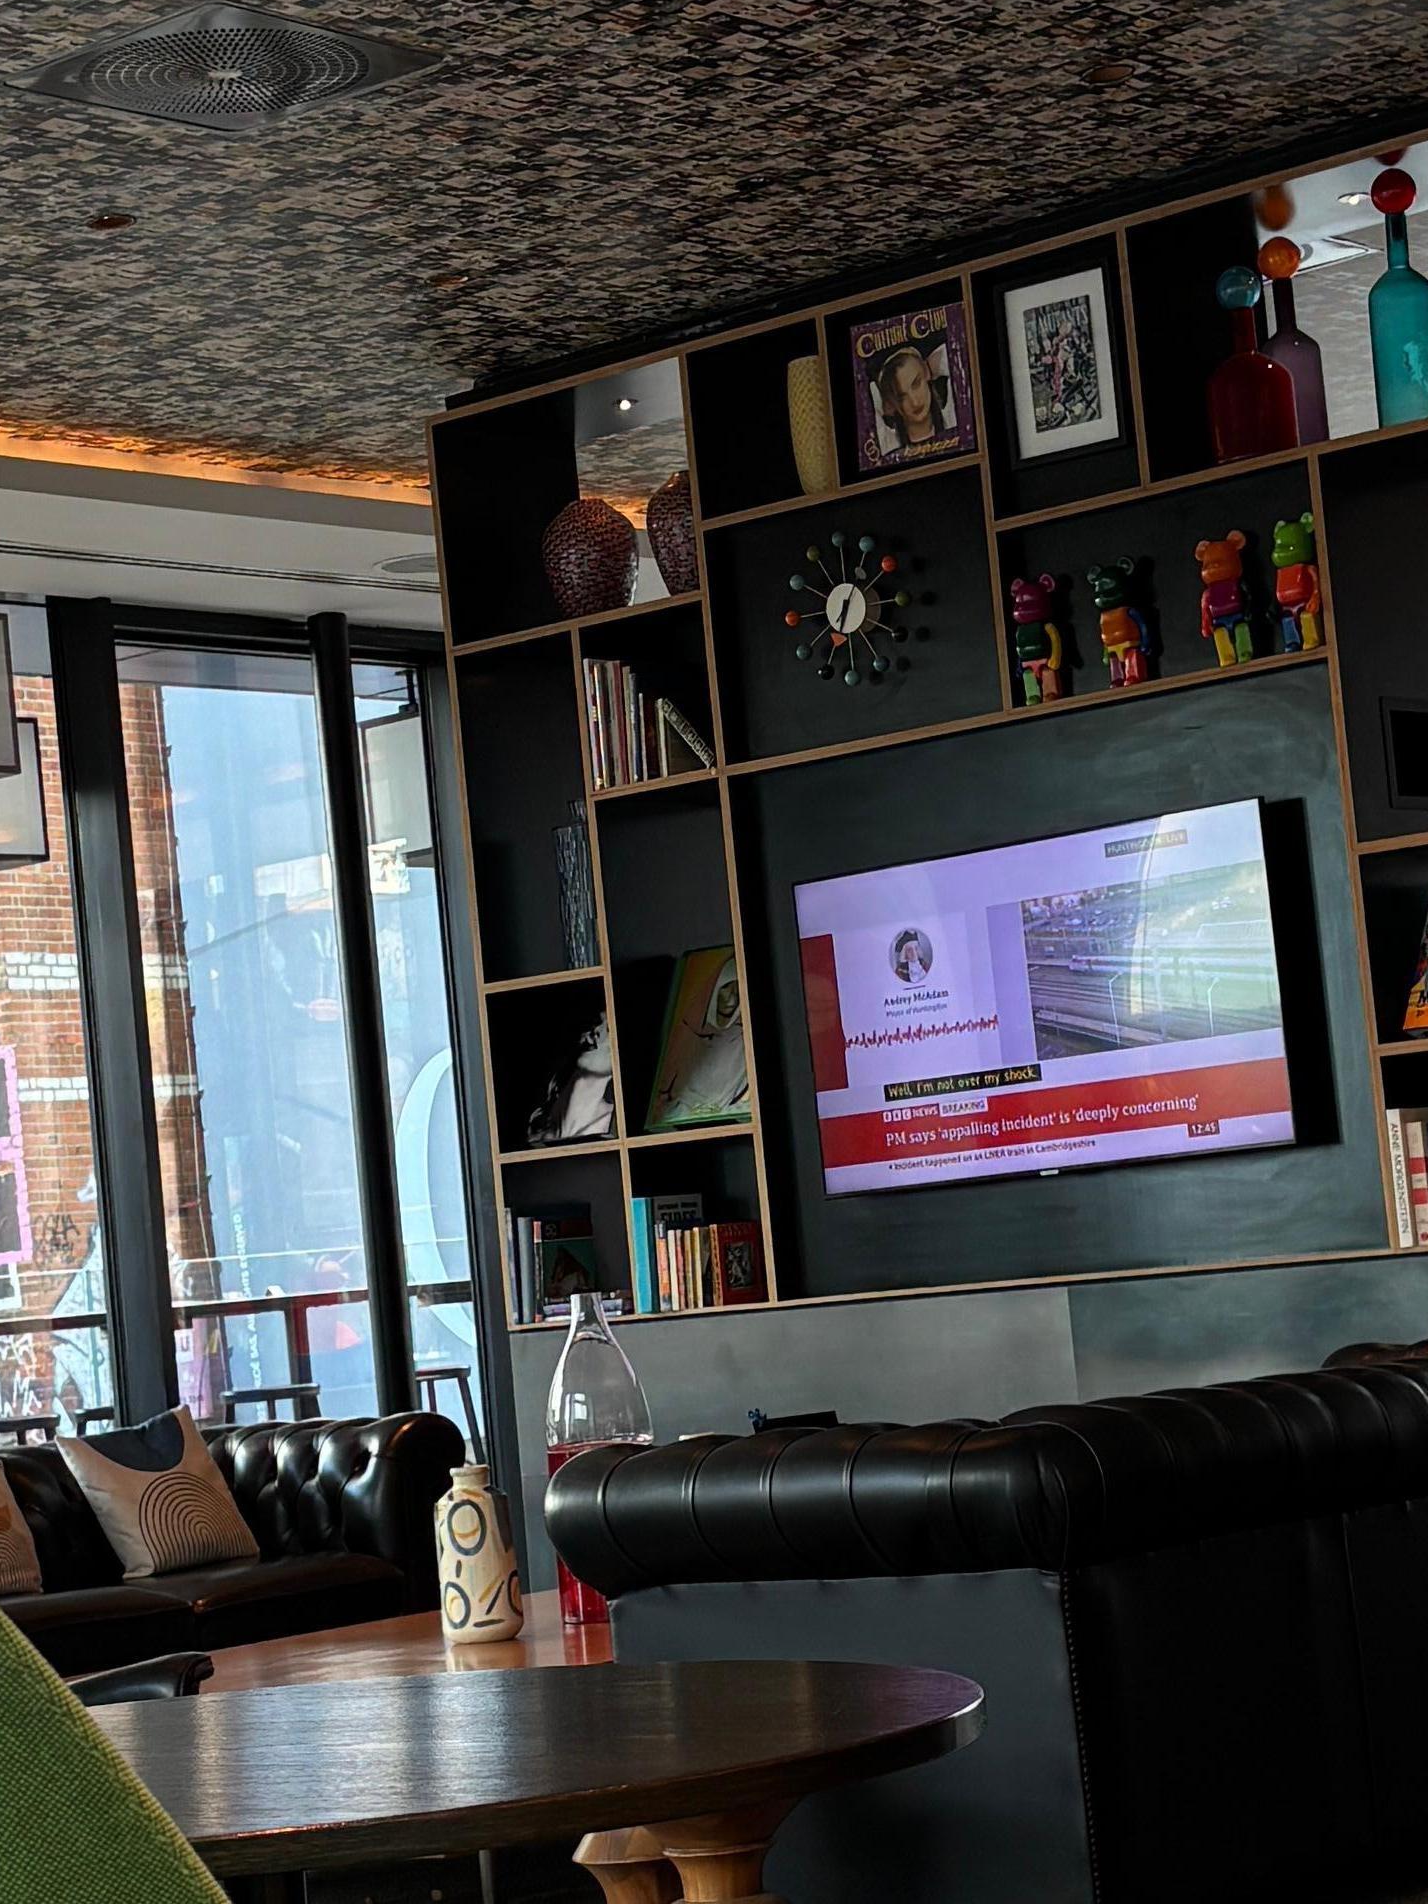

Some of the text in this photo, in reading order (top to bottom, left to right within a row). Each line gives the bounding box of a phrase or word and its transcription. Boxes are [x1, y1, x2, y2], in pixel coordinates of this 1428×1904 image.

[937, 1078, 954, 1090] not
[958, 1077, 980, 1087] over
[984, 1074, 1000, 1085] my
[942, 1099, 985, 1114] BREAKING
[886, 1131, 906, 1146] PM
[909, 1130, 936, 1145] says
[1059, 1111, 1070, 1124] is
